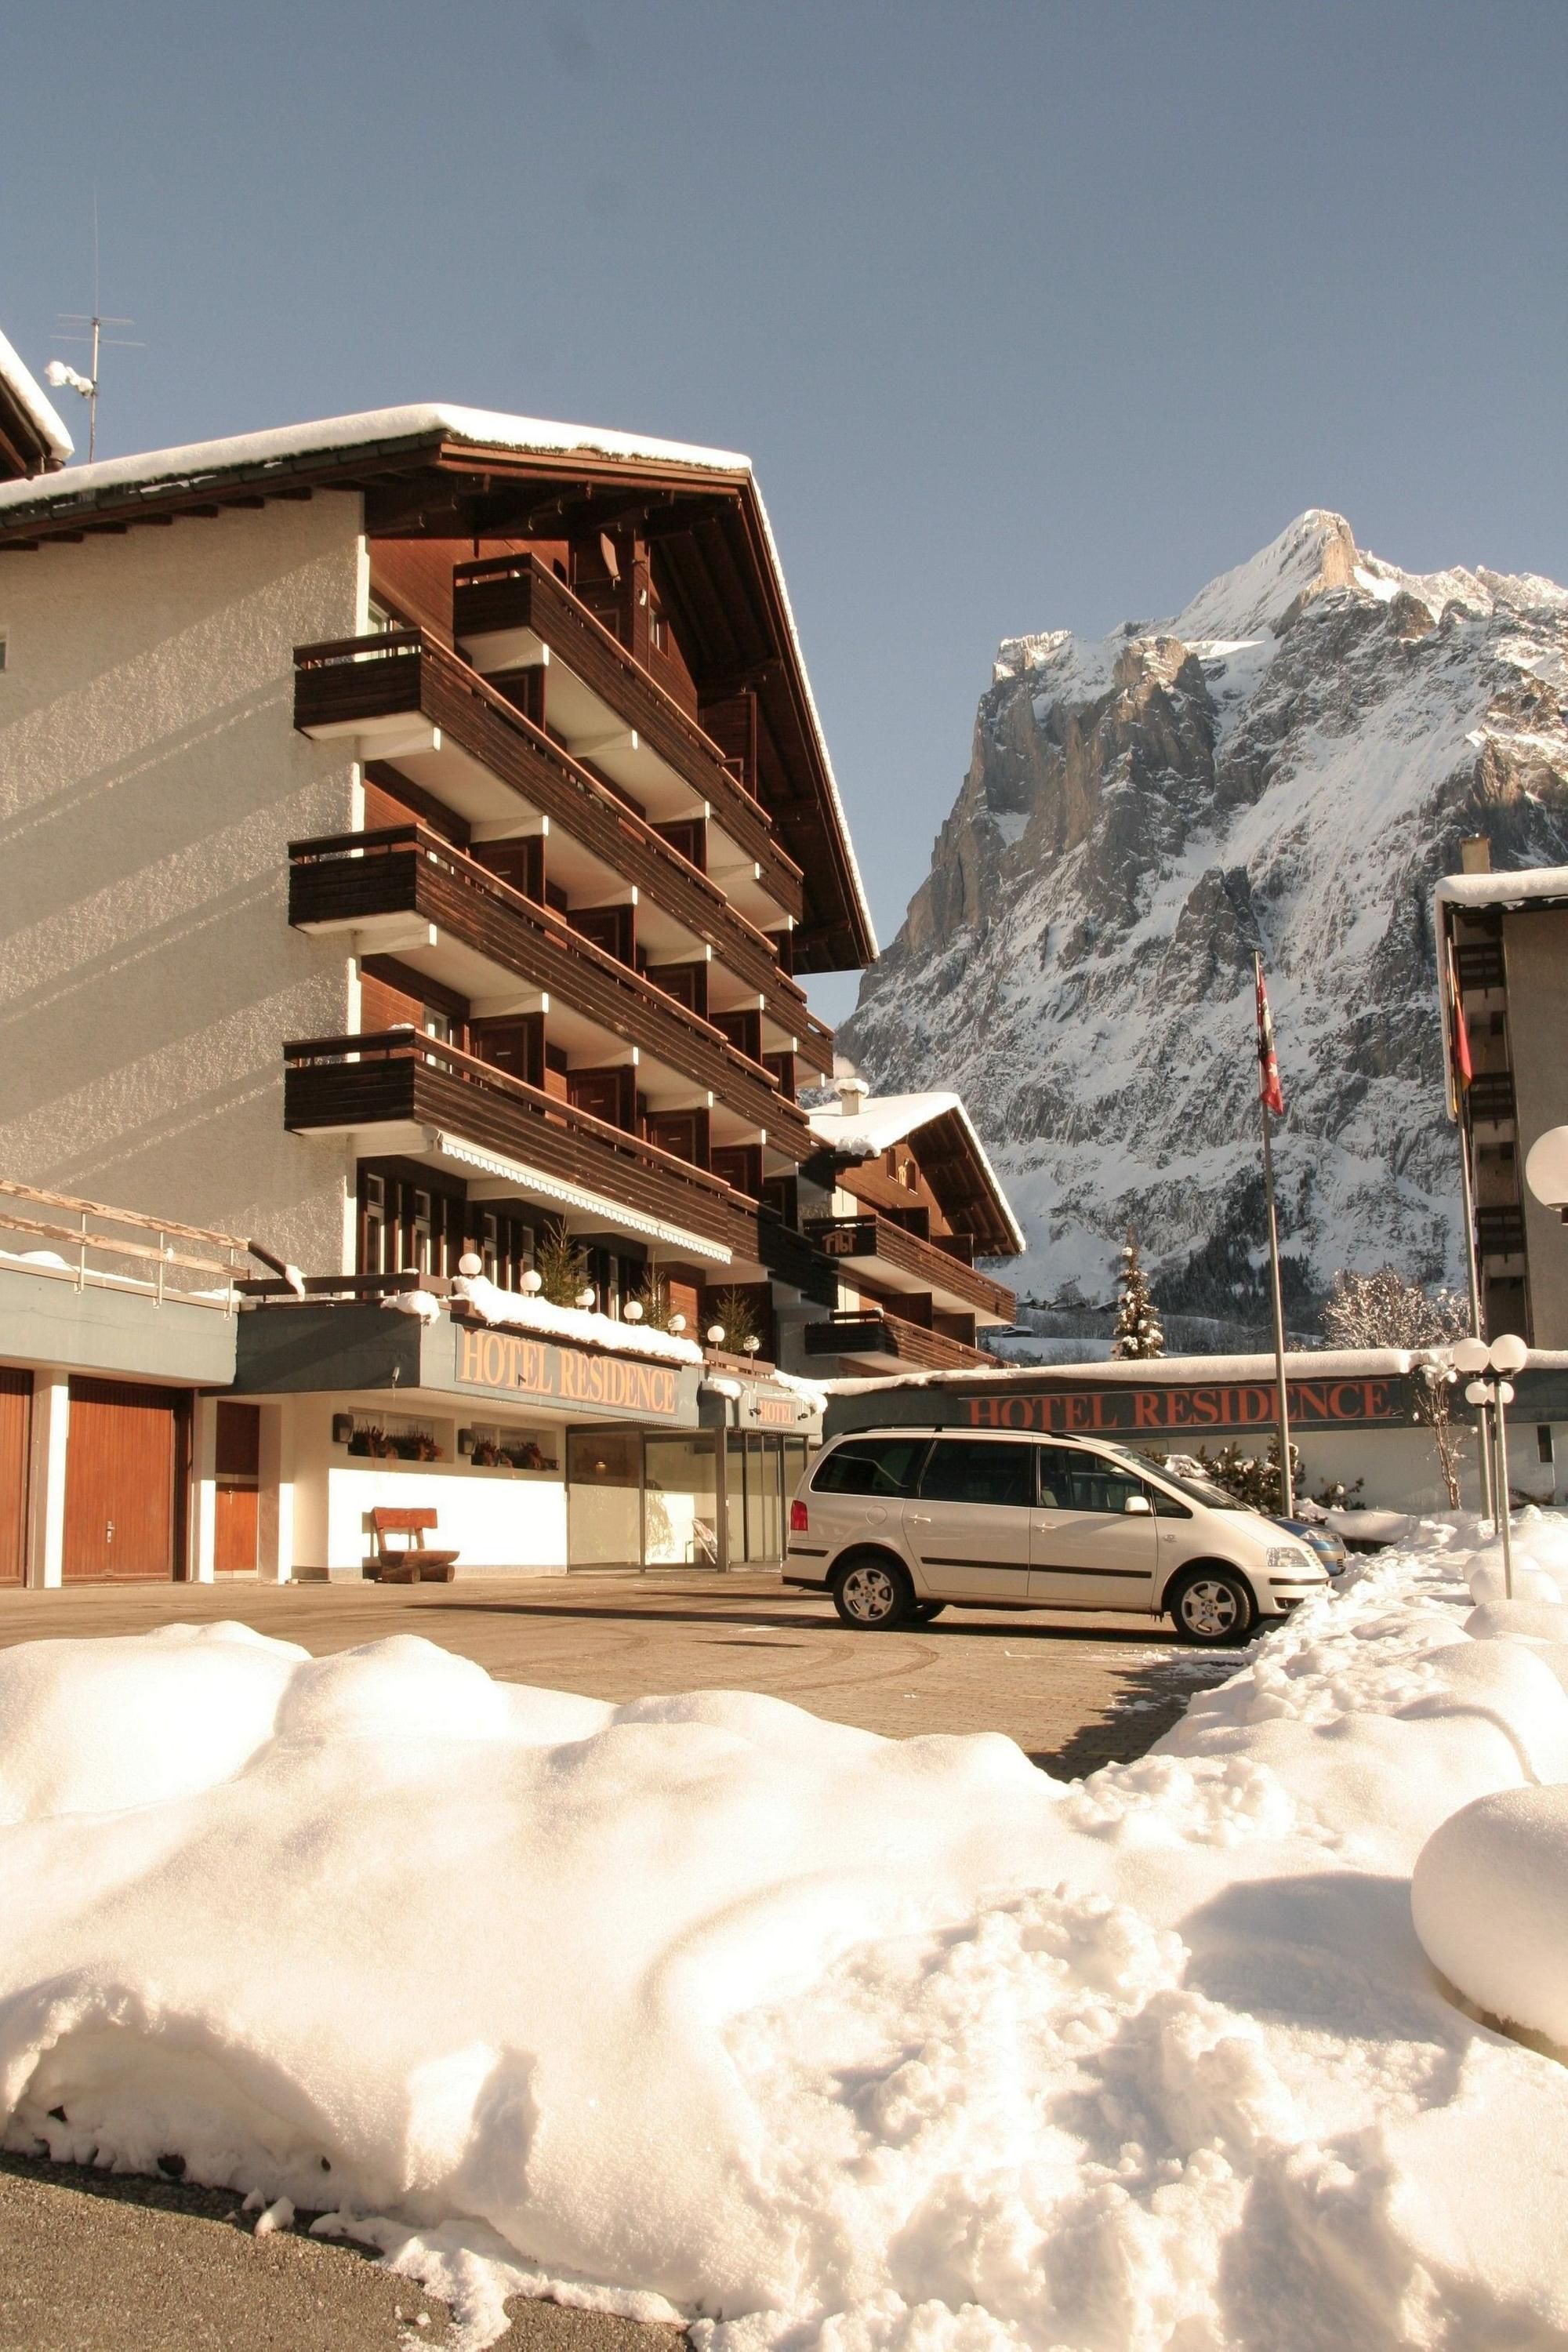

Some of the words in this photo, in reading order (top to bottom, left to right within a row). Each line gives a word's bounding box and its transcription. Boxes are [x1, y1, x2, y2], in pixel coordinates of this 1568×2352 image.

[460, 1330, 552, 1394] HOTEL
[559, 1348, 675, 1412] RESIDENCE
[759, 1400, 794, 1425] HOTEL
[969, 1393, 1117, 1432] HOTEL
[1131, 1382, 1391, 1427] RESIDENCE
